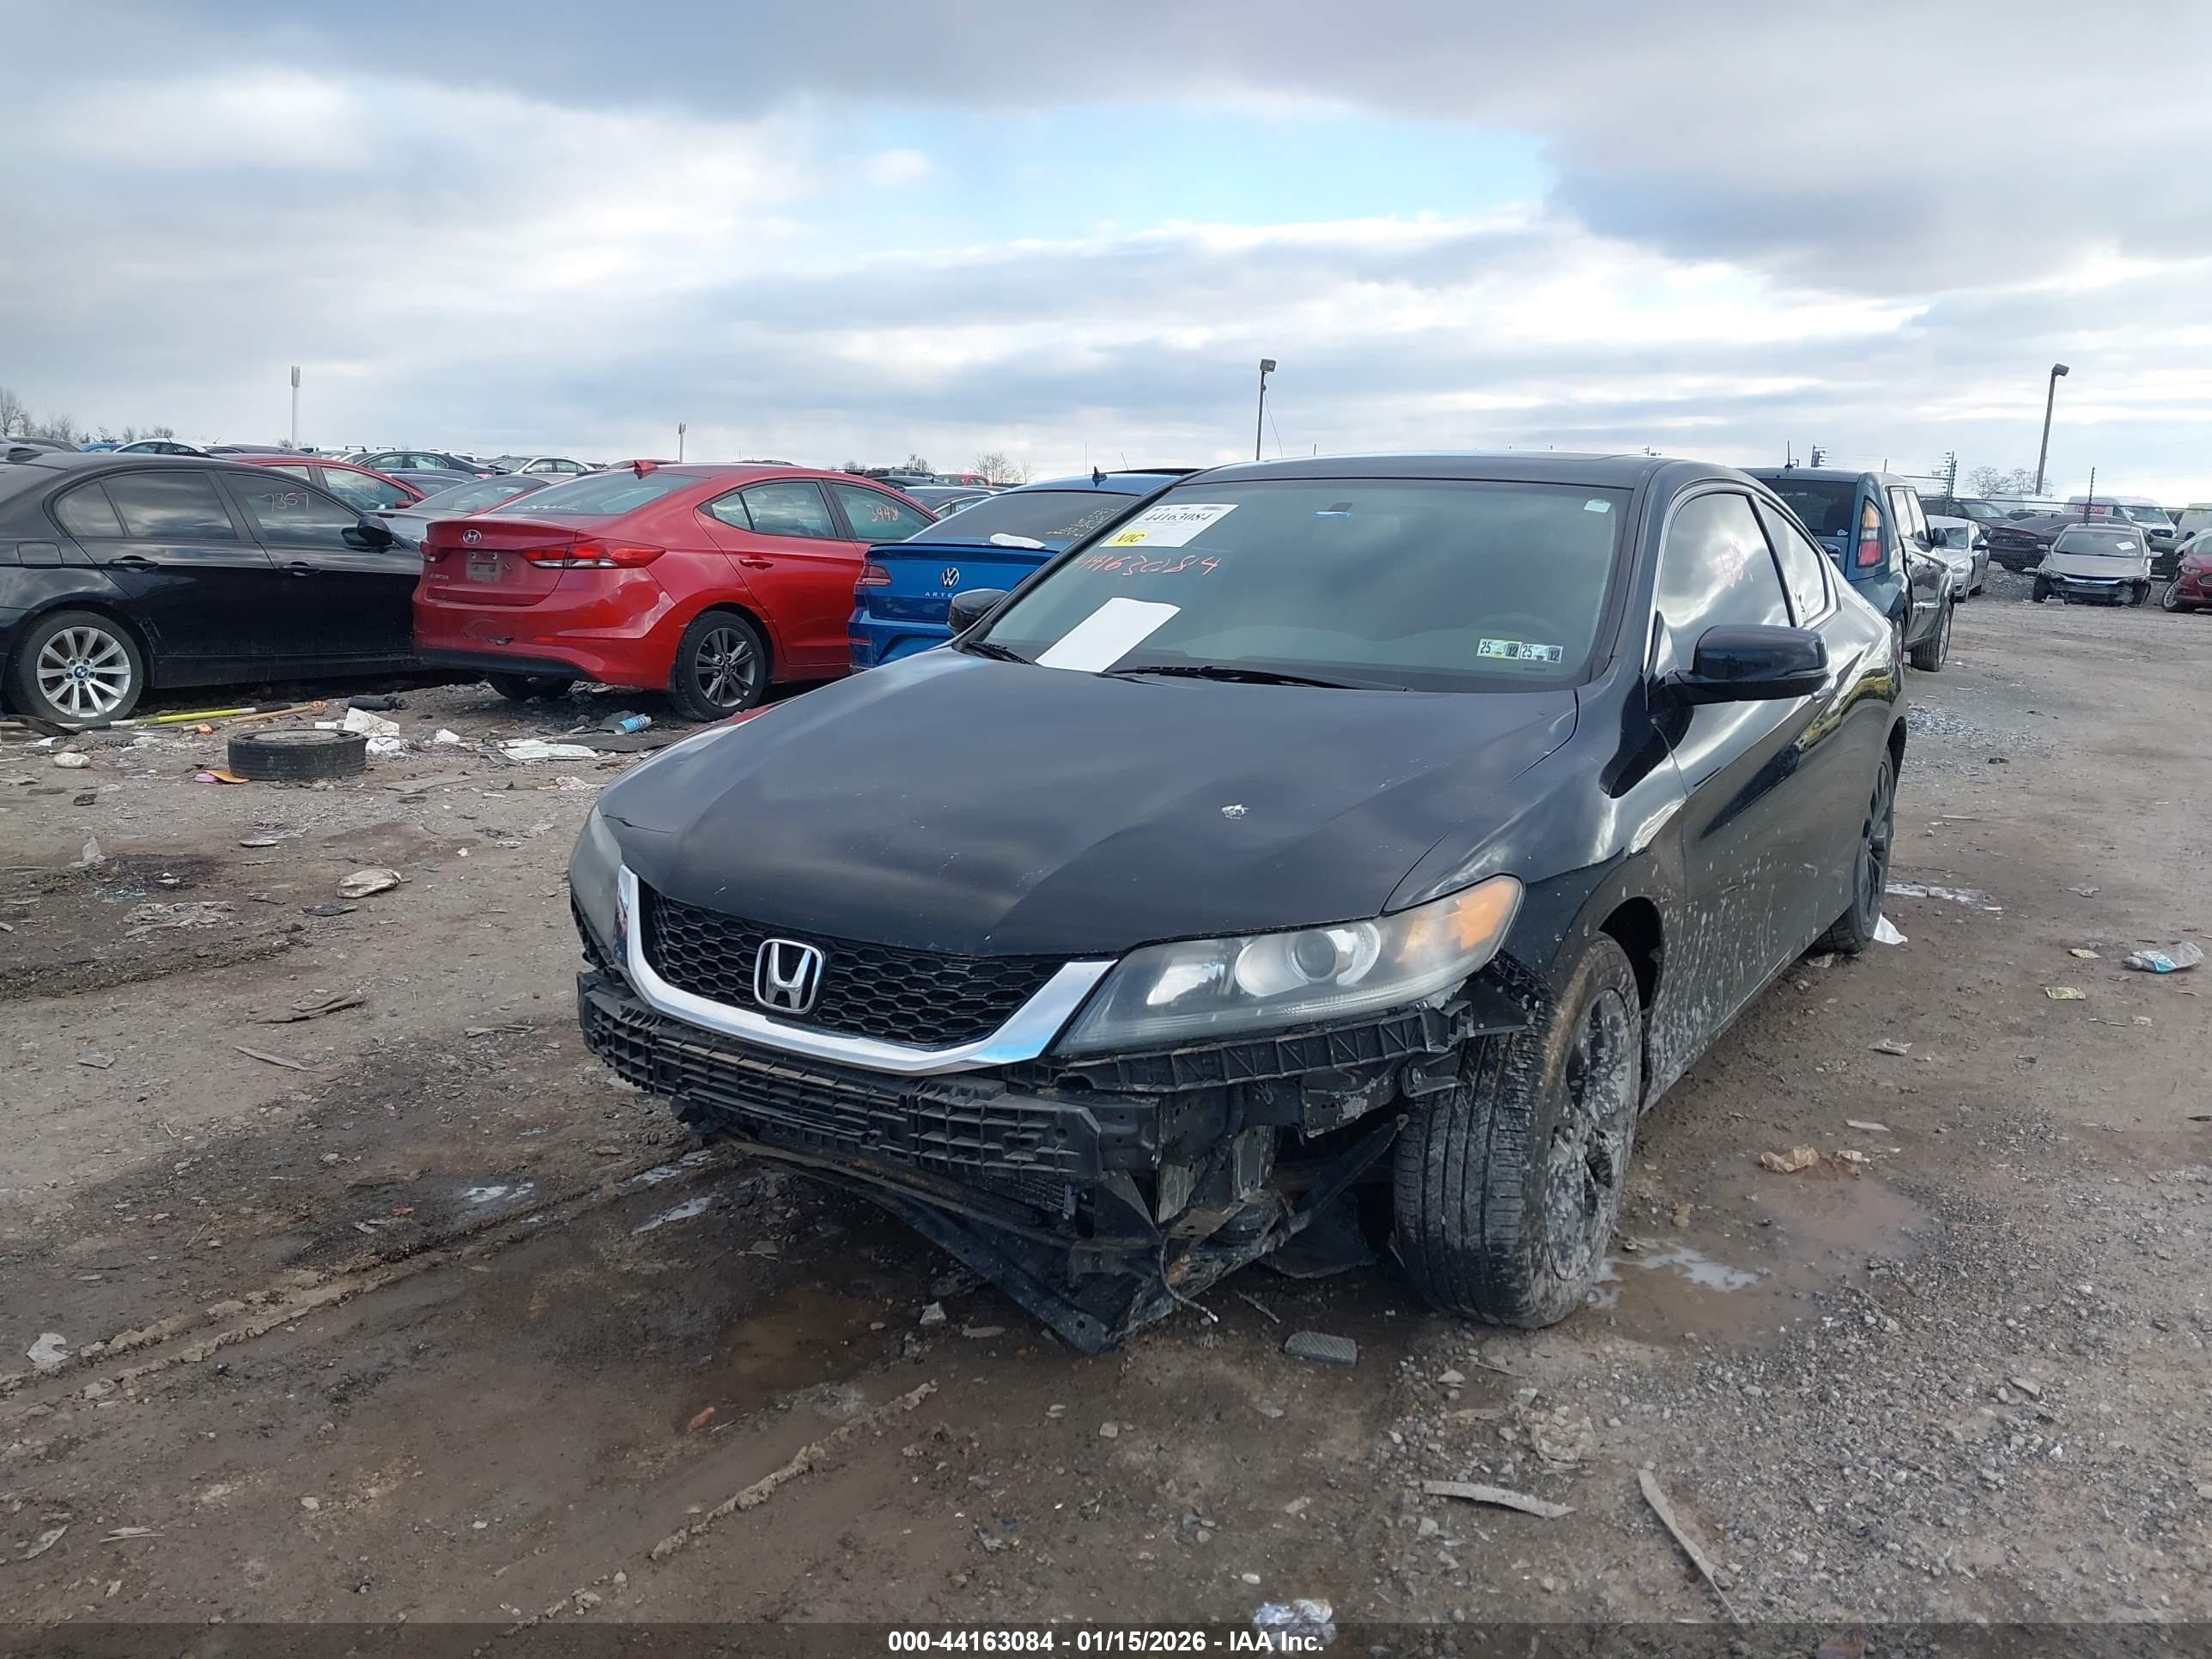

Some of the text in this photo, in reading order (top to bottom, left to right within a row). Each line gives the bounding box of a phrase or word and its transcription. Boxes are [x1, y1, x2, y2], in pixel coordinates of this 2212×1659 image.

[1145, 513, 1212, 522] 44163084
[1117, 533, 1146, 543] VIC
[1480, 641, 1519, 658] 25 12
[1522, 645, 1534, 658] 25
